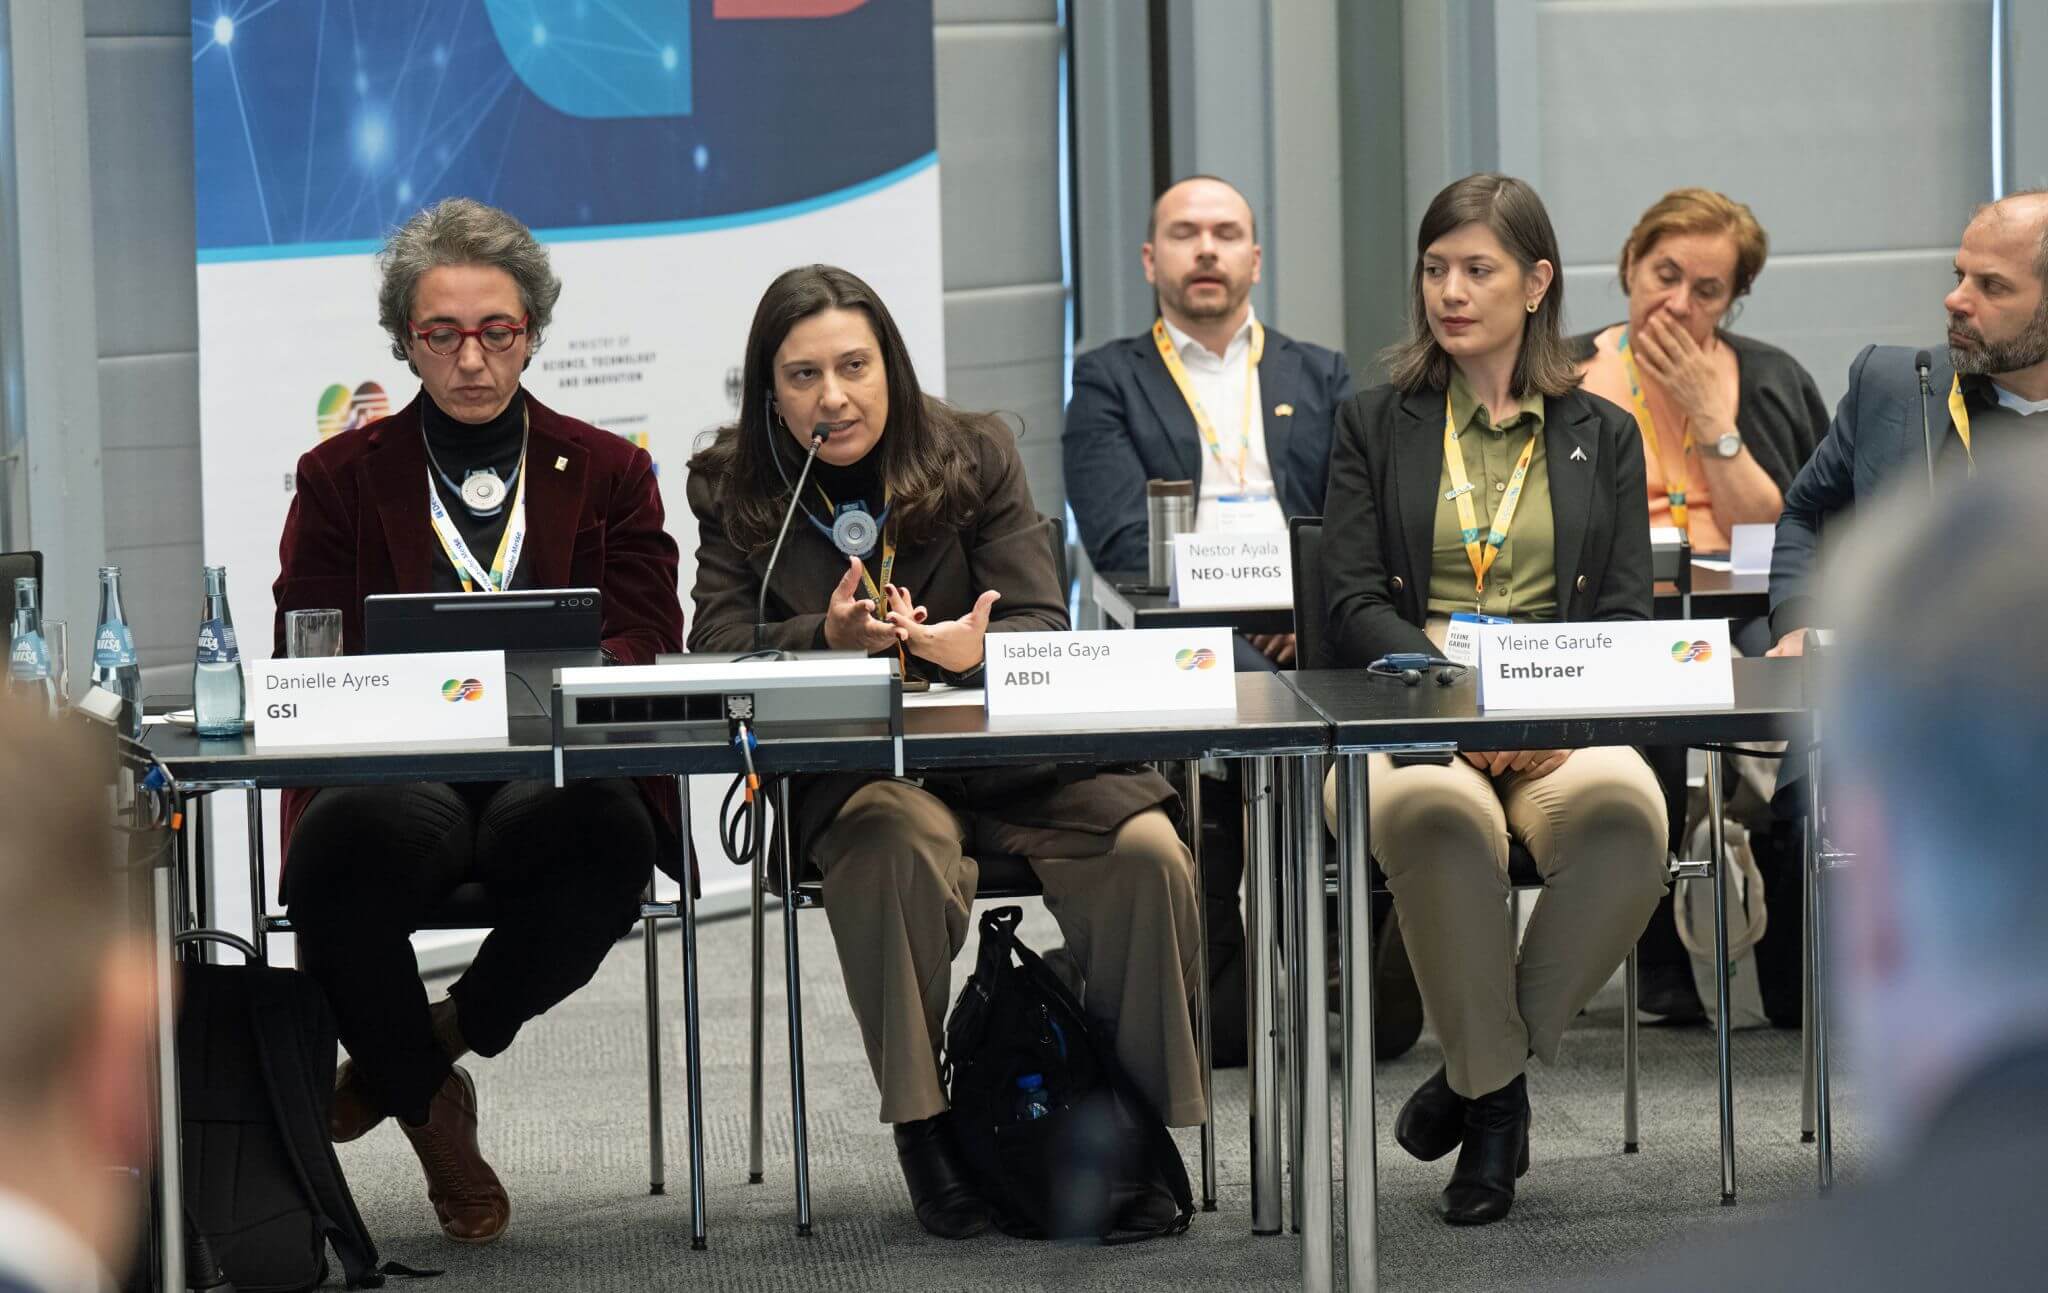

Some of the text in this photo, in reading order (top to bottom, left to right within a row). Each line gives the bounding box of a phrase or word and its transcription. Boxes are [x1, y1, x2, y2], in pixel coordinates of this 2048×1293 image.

[591, 352, 656, 368] TECHNOLOGY
[559, 372, 643, 388] AND INNOVATION
[510, 531, 524, 555] Messe
[1189, 541, 1279, 558] Nestor Ayala
[1191, 566, 1282, 580] NEO-UFRGS
[1497, 633, 1613, 651] Yleine Garufe
[1003, 642, 1110, 660] Isabela Gaya
[1004, 671, 1050, 686] ABDI
[1500, 662, 1584, 679] Embraer
[266, 672, 390, 691] Danielle Ayres
[266, 704, 297, 719] GSI
